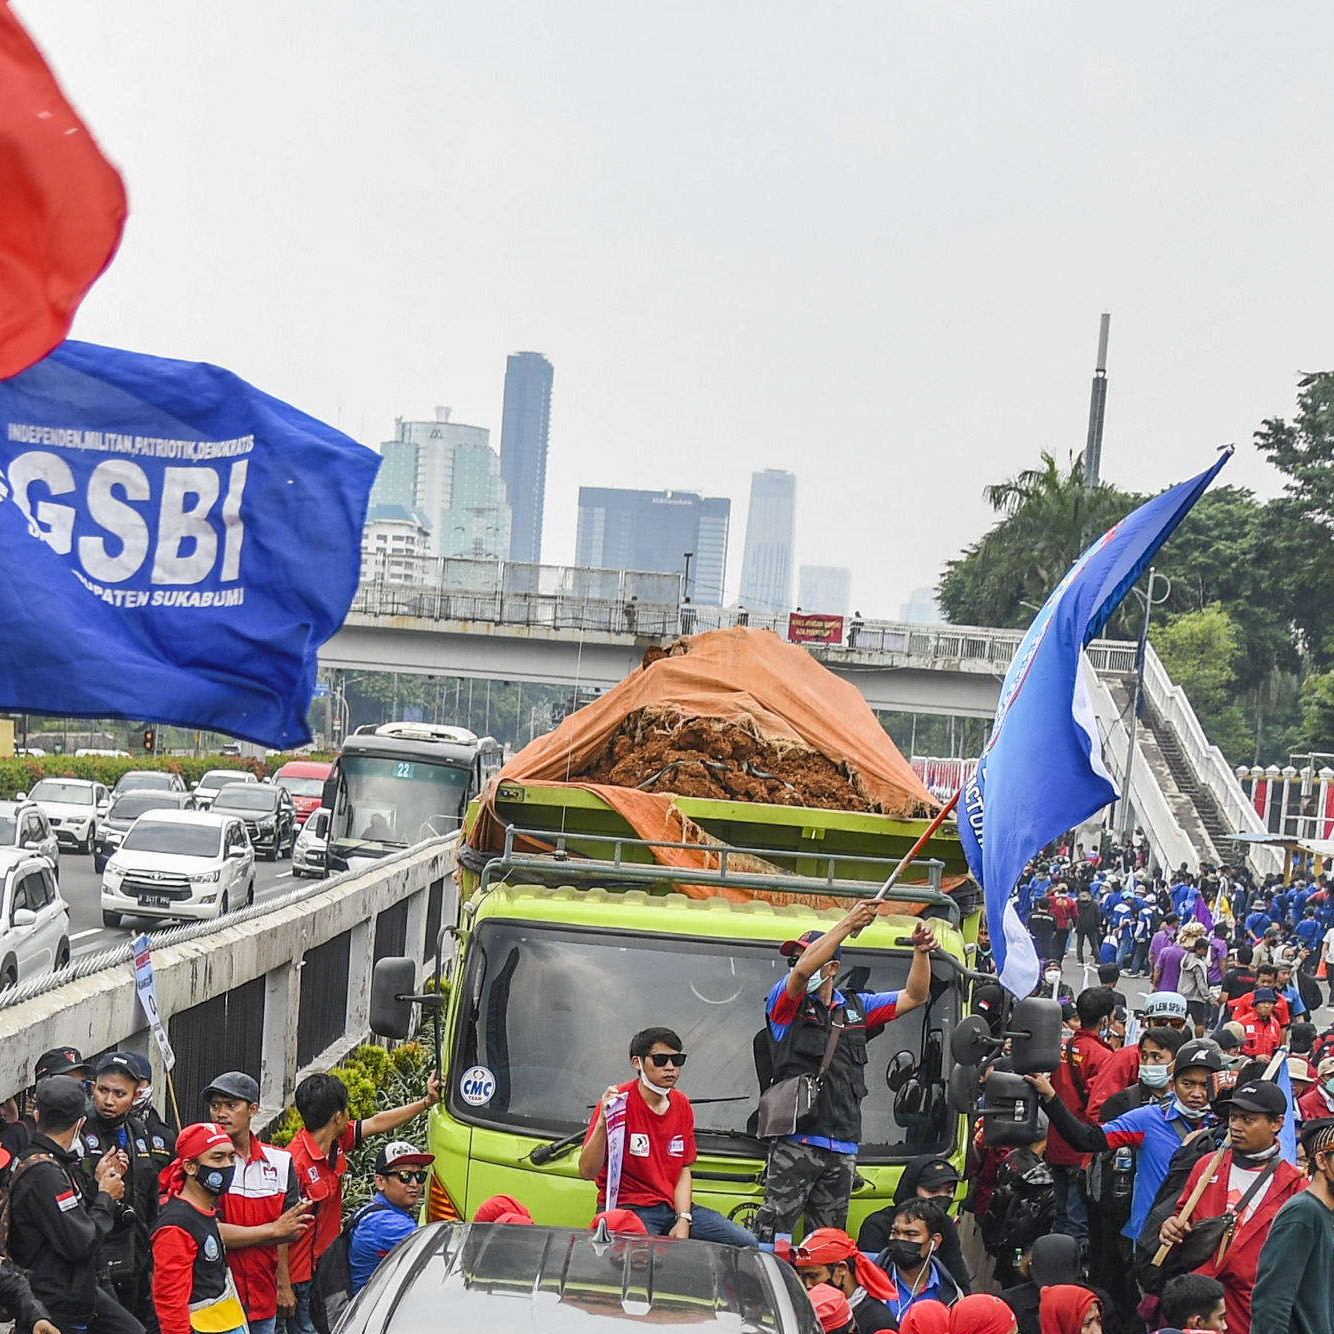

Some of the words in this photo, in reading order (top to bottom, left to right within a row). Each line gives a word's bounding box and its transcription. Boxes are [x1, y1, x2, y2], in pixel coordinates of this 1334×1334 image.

[8, 449, 250, 585] GSBI
[151, 586, 245, 607] SUKABUMI
[397, 763, 409, 778] 22
[464, 1079, 493, 1097] CMC
